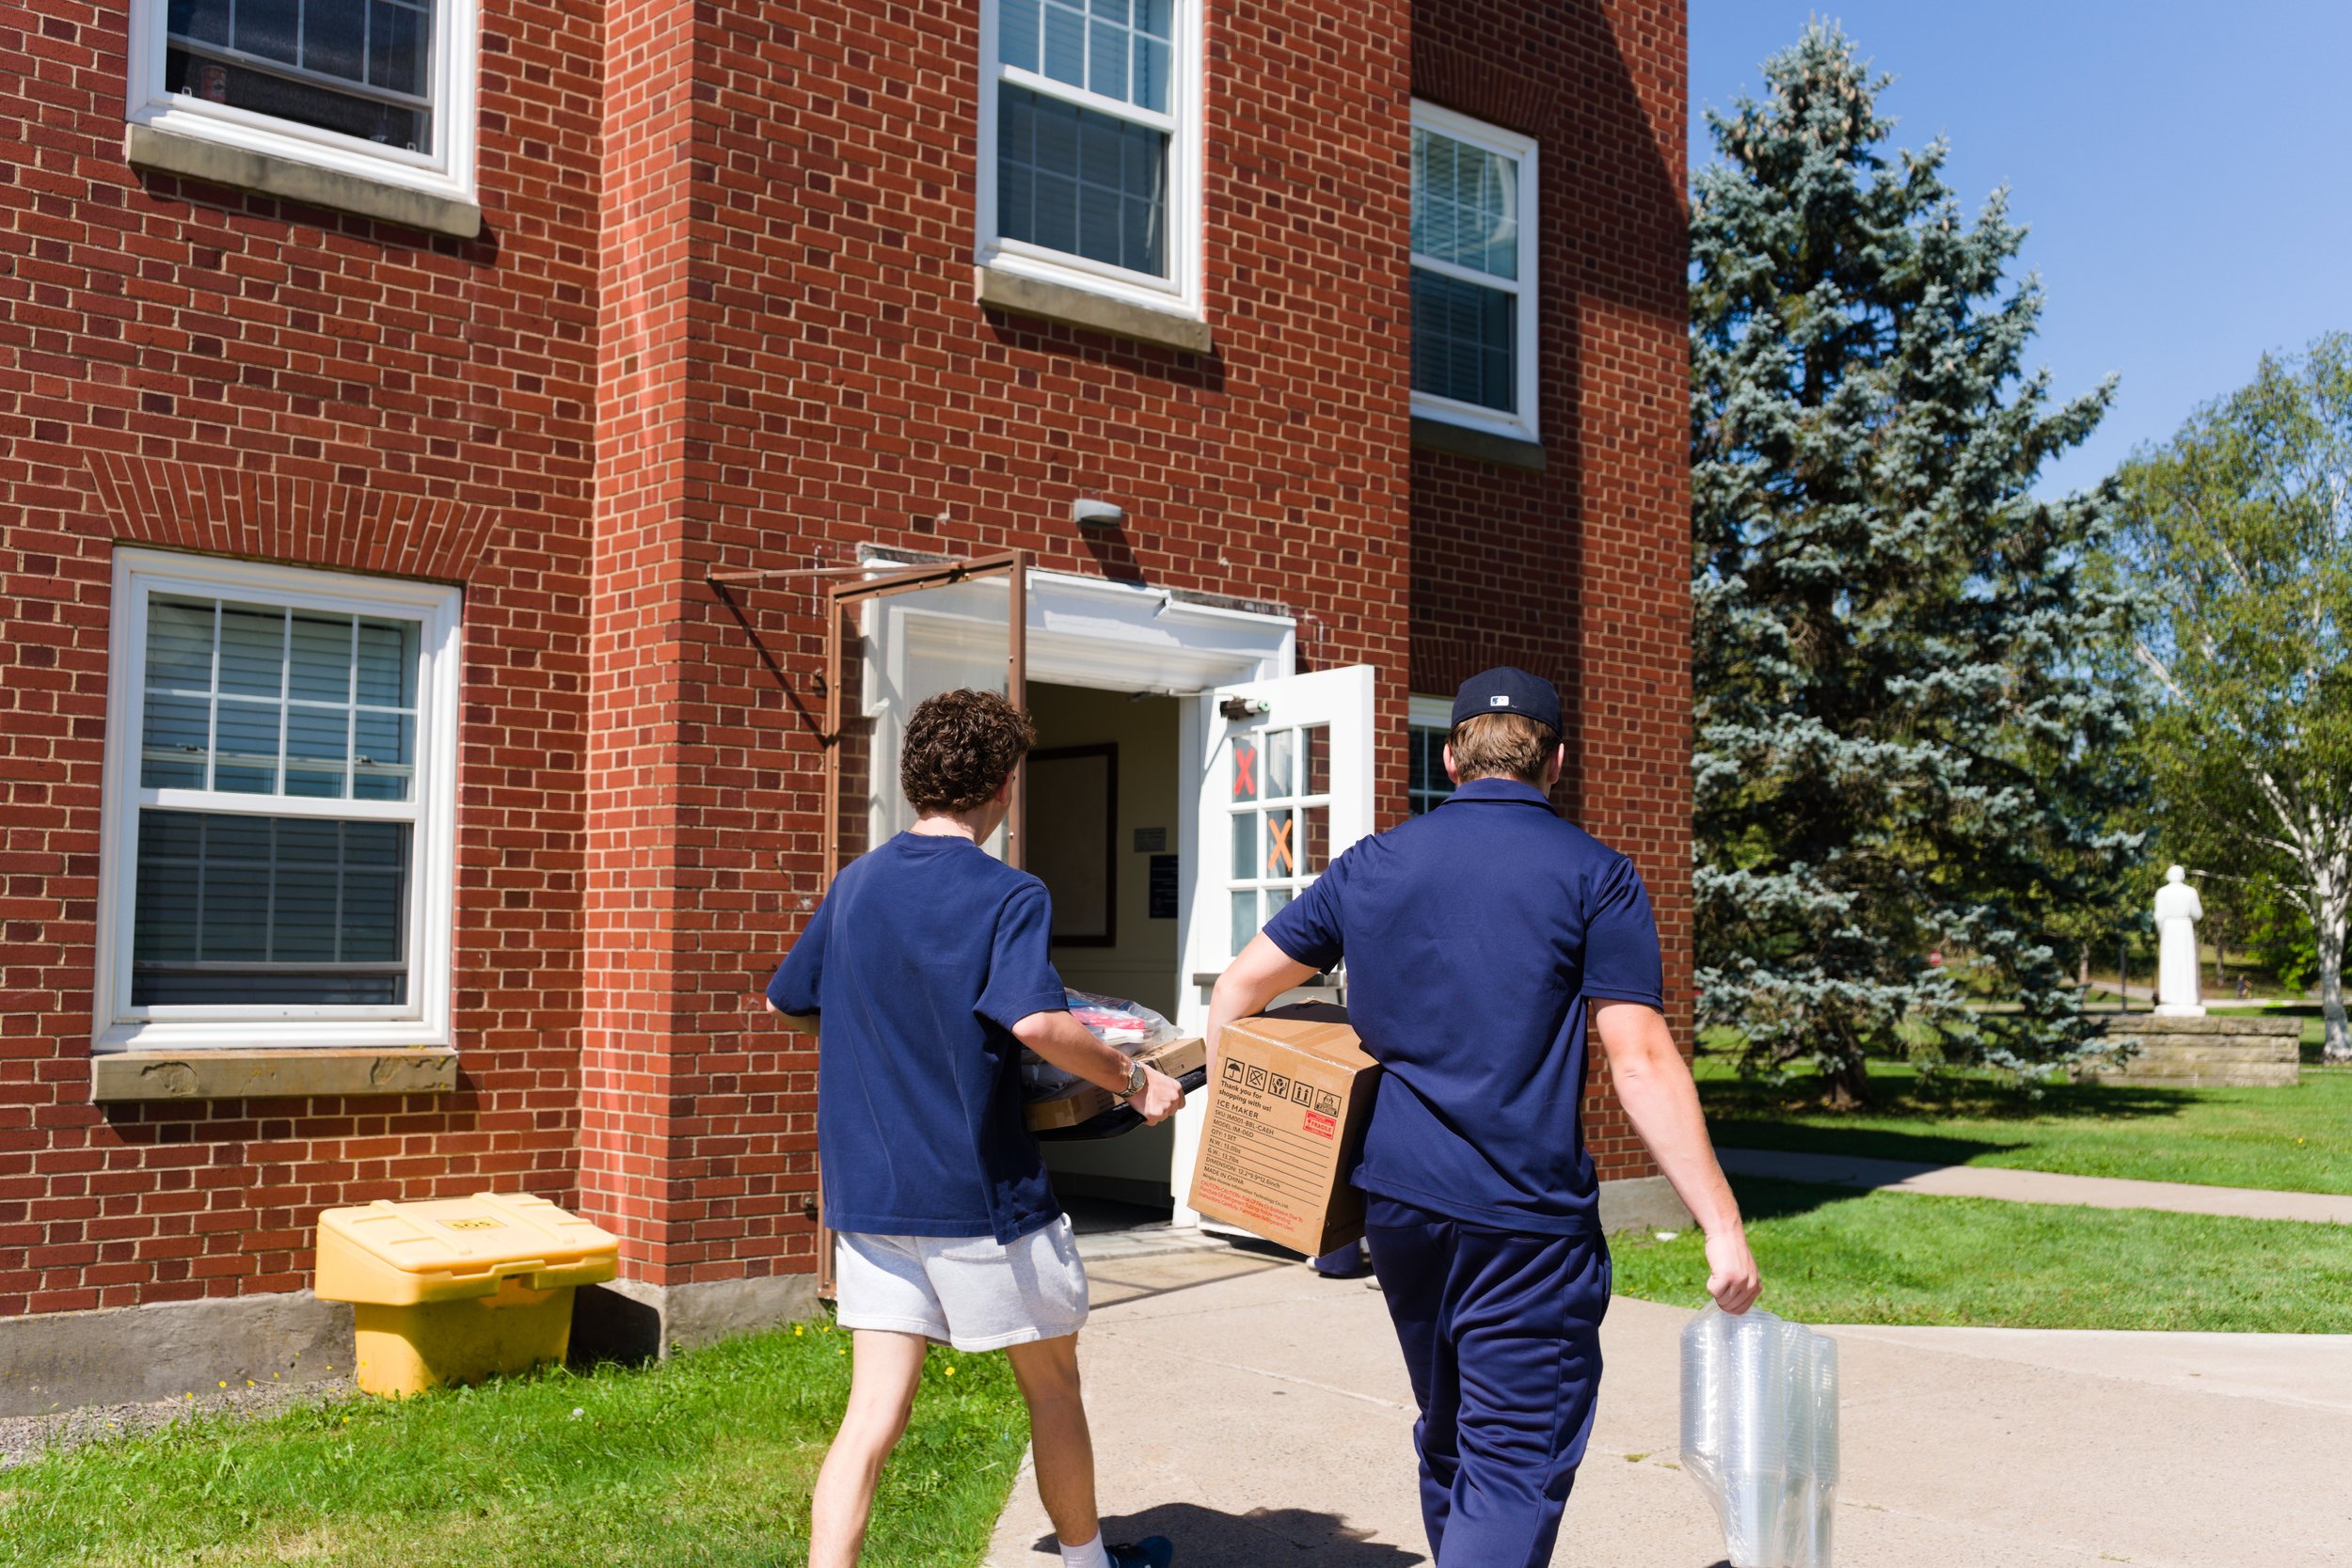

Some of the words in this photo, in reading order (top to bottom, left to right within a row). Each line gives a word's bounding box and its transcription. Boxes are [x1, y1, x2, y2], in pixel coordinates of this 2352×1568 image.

[1220, 1081, 1239, 1091] Thank
[1240, 1088, 1251, 1098] you
[1252, 1091, 1263, 1100] for
[1218, 1088, 1247, 1104] shopping
[1248, 1099, 1262, 1108] with
[1262, 1103, 1272, 1112] us!
[1217, 1099, 1230, 1109] ICE
[1232, 1104, 1259, 1119] MAKER
[1211, 1129, 1223, 1137] QTY:
[1311, 1120, 1332, 1132] FRAGILE
[1224, 1143, 1241, 1154] 13.0lbs
[1206, 1156, 1237, 1172] DIMENSION:
[1222, 1153, 1239, 1164] 13.7lbs
[1204, 1166, 1219, 1176] MADE
[1227, 1175, 1244, 1185] CHINA
[1232, 1183, 1253, 1196] Information
[1253, 1192, 1275, 1204] Technology
[1289, 1212, 1298, 1221] Due
